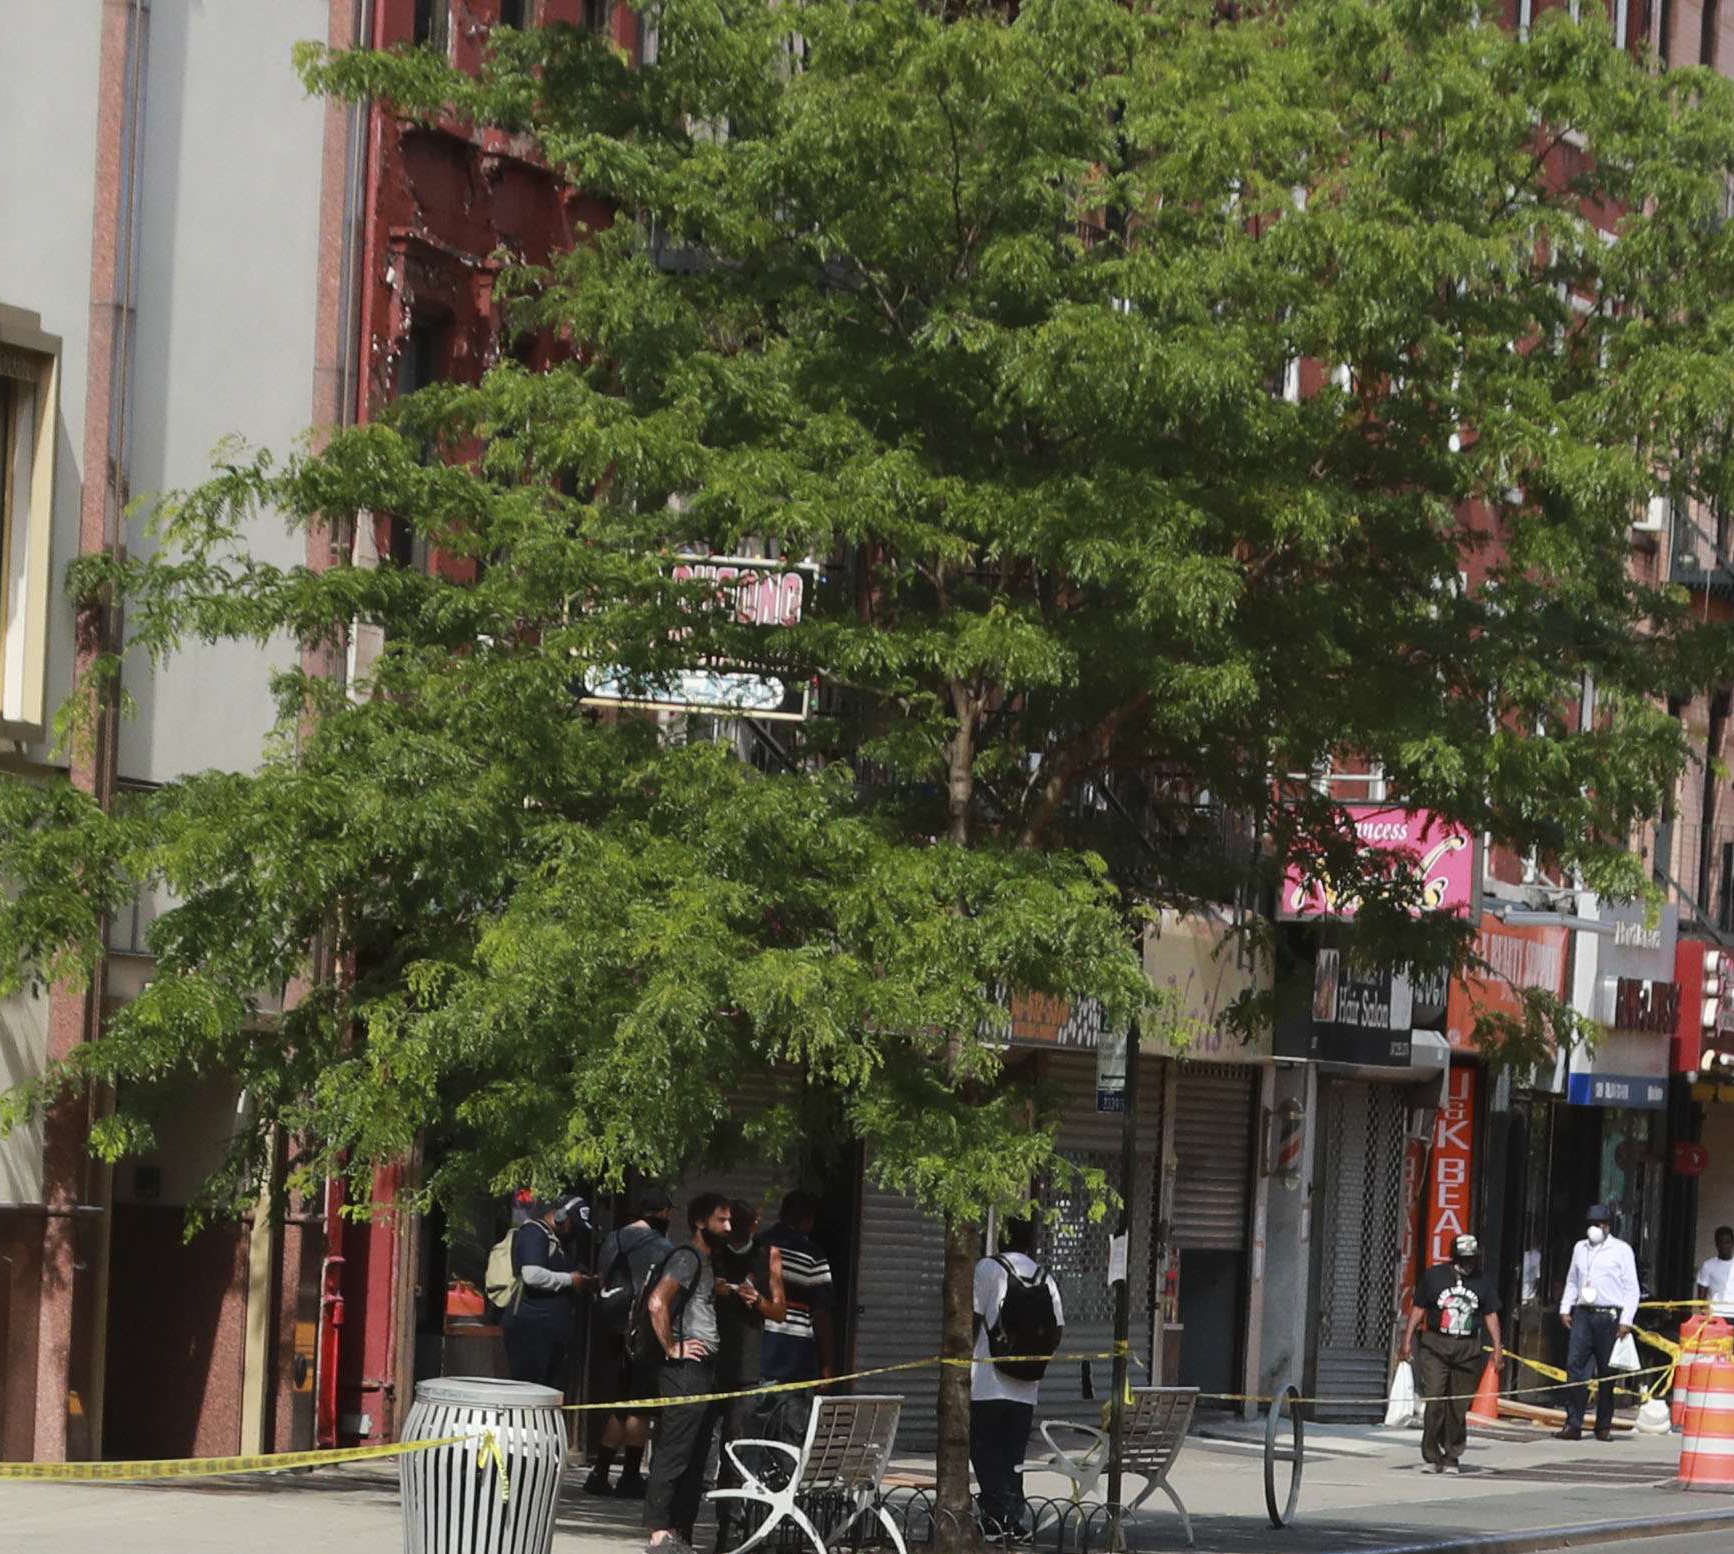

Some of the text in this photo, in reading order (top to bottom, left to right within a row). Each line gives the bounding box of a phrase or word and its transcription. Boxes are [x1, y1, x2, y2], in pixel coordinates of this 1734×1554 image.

[1337, 985, 1389, 1029] Hair Salon
[1436, 1119, 1471, 1151] K
